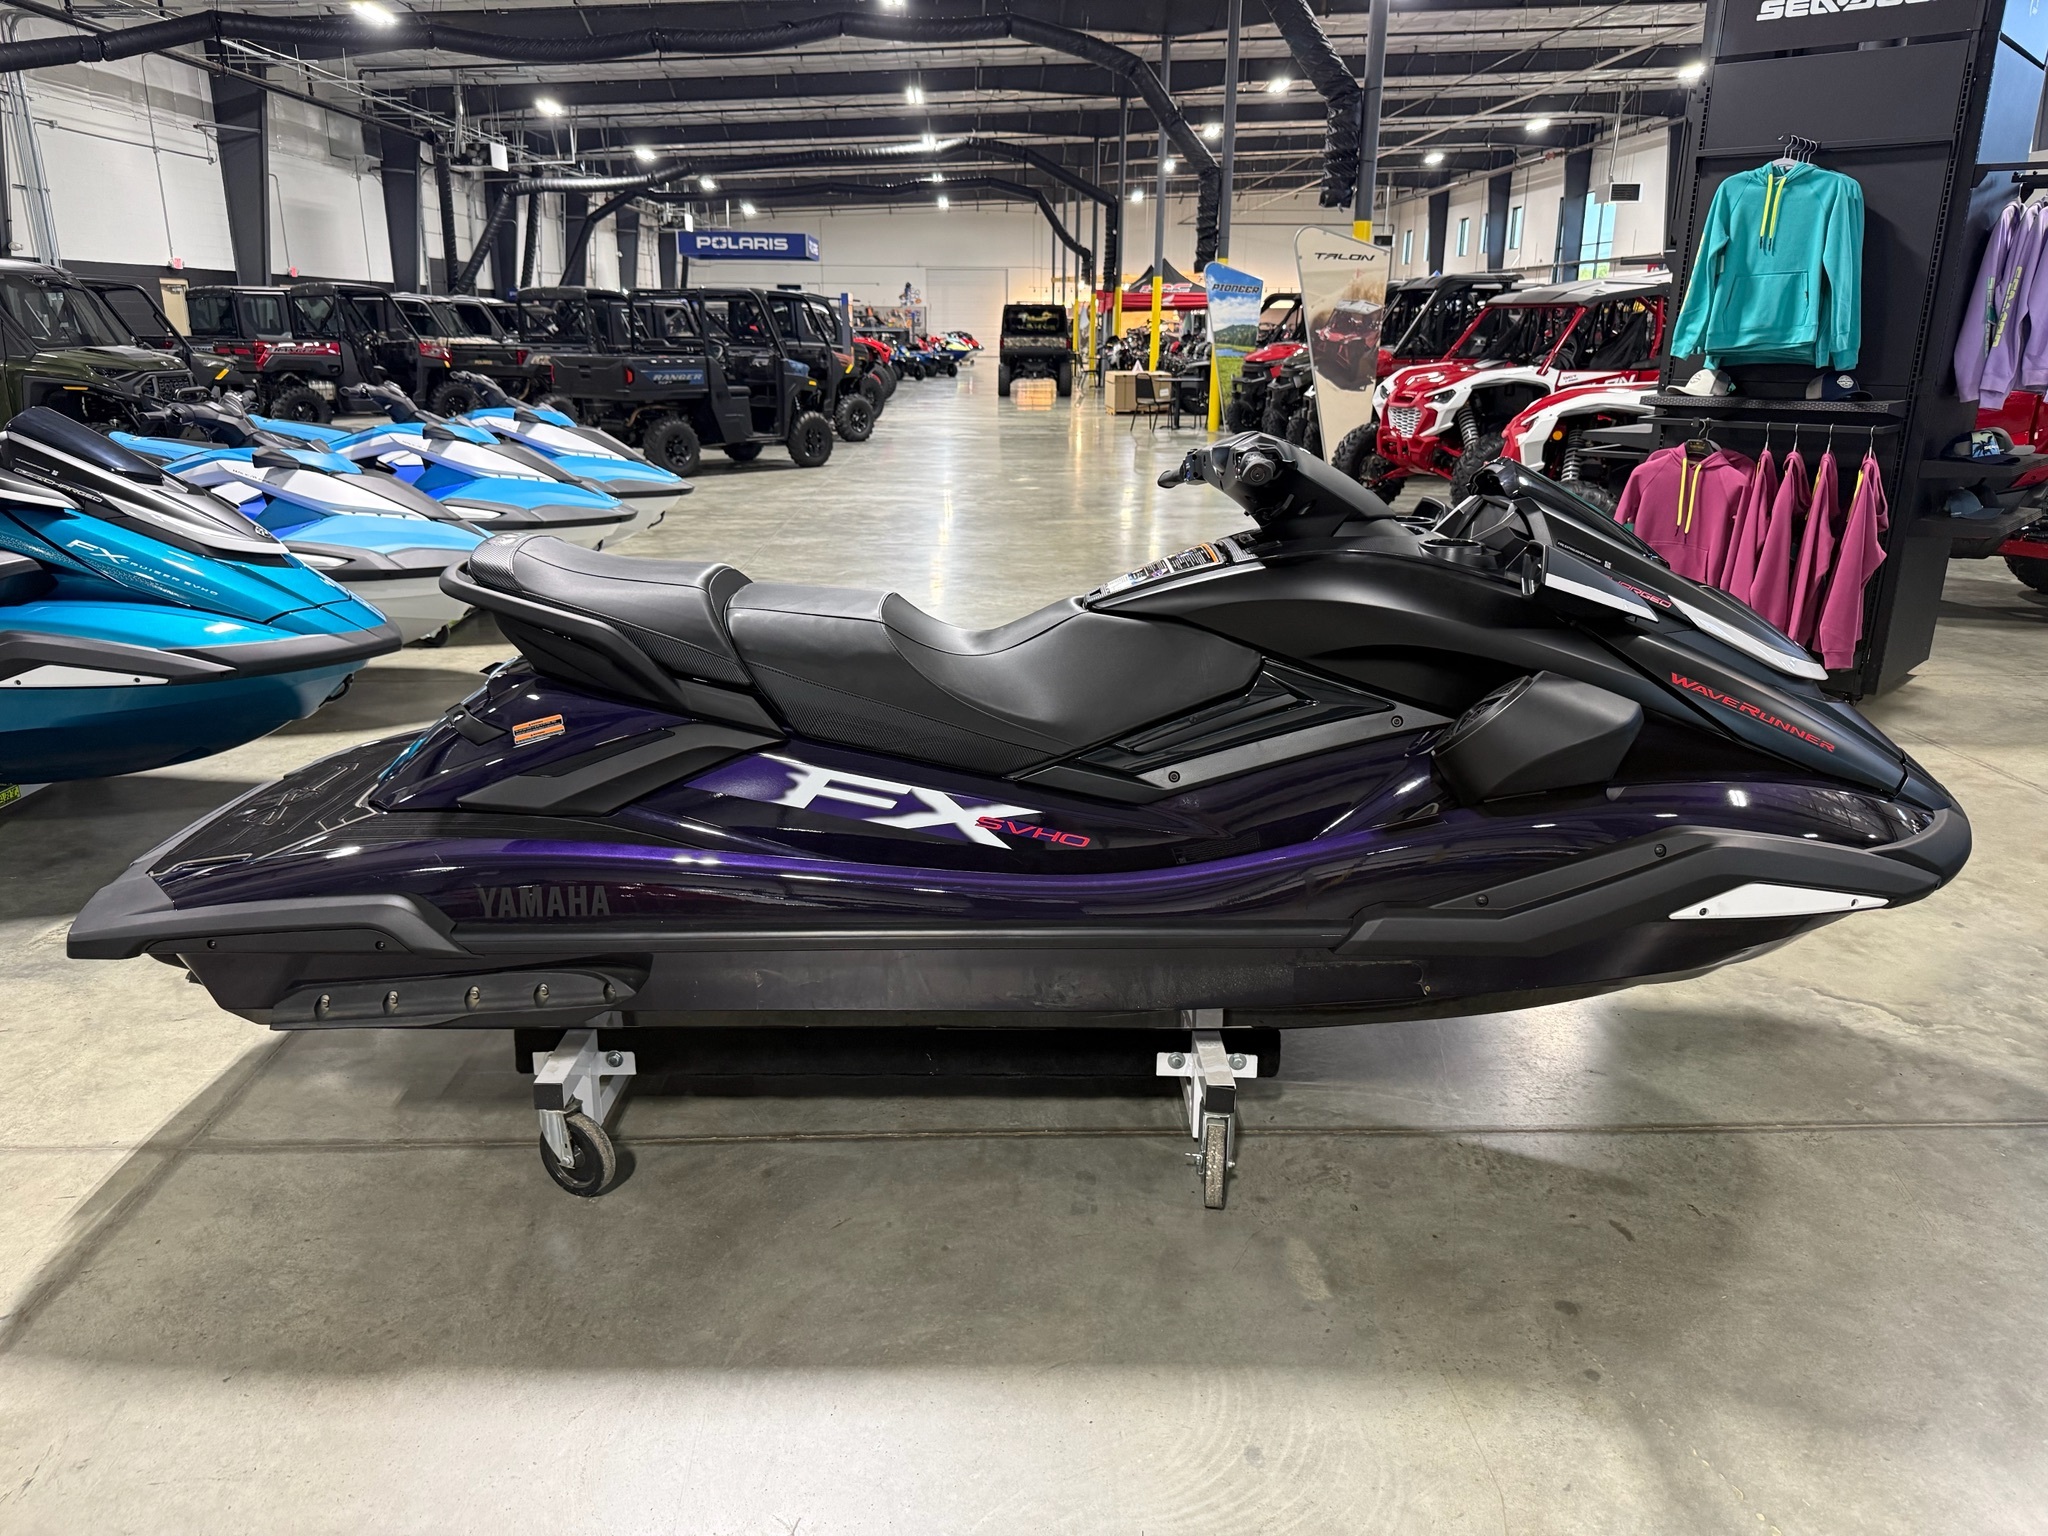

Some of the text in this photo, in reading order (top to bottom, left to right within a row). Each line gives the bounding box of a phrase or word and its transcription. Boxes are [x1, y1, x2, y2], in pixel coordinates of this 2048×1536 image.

[695, 236, 789, 251] POLARIS
[1314, 252, 1376, 262] TALON
[1211, 283, 1260, 294] PIONEER
[653, 373, 703, 381] RANGER
[66, 539, 219, 596] FX CRUISER SVHO
[1670, 671, 1836, 752] WAVERUNNER
[782, 762, 1091, 850] FX SVHO
[476, 885, 612, 919] YAMAHA
